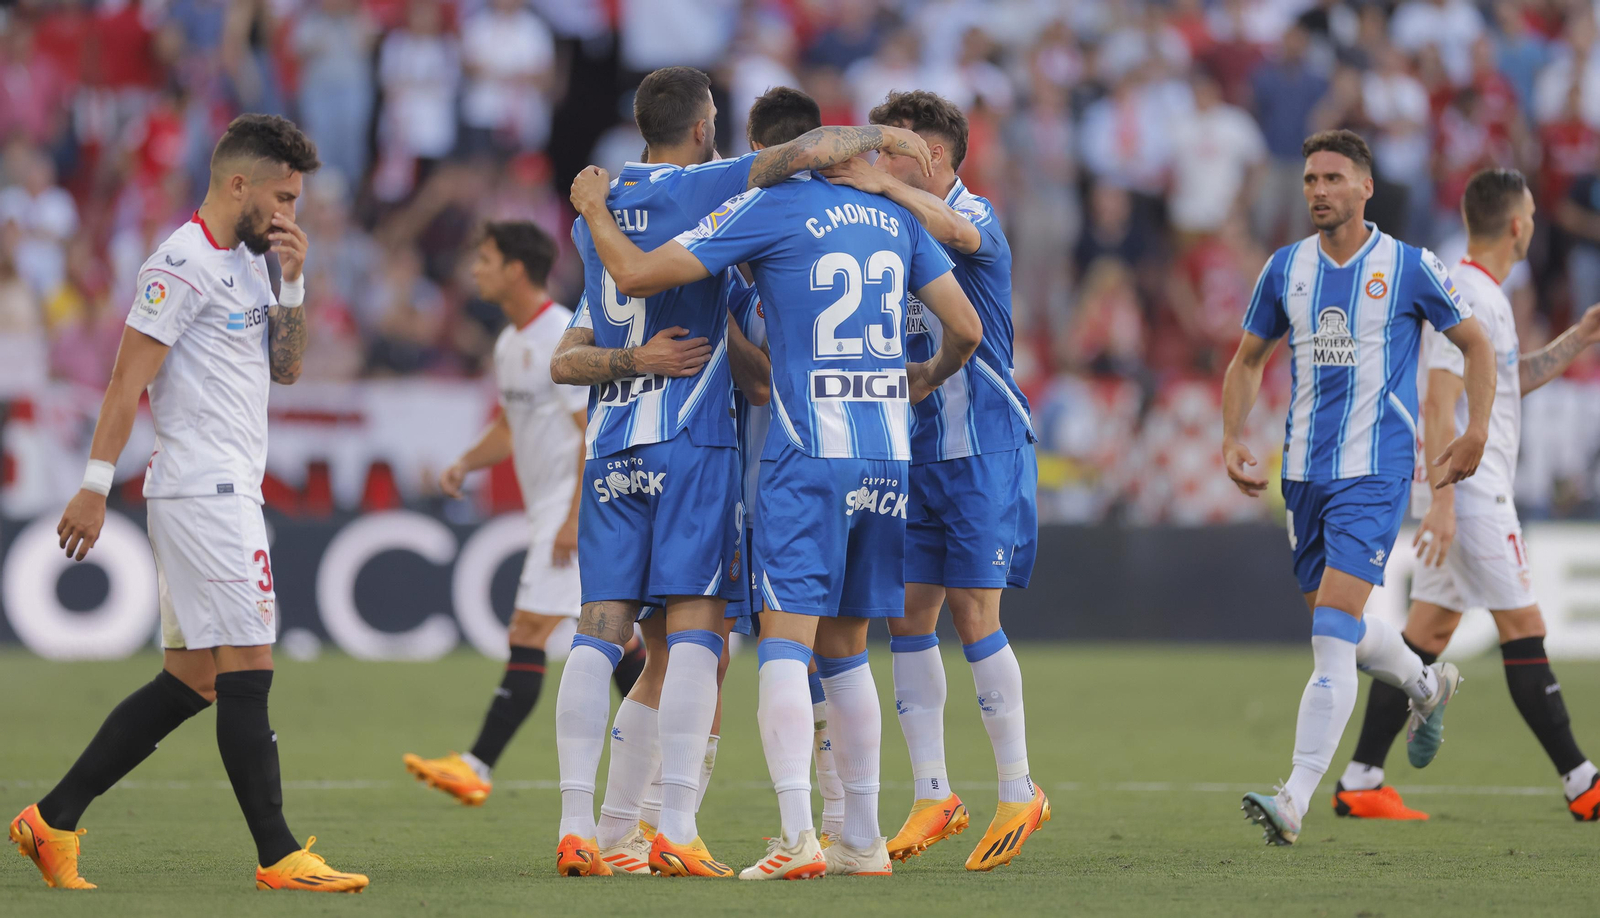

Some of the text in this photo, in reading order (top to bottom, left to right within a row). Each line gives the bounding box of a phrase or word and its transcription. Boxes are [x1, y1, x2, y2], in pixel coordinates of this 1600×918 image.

[244, 304, 269, 329] DEGIR
[810, 250, 905, 361] 23
[1313, 336, 1354, 348] RIVIERA
[1313, 349, 1355, 364] MAYA
[814, 375, 907, 399] DIGI
[862, 477, 898, 487] CRYPTO
[253, 548, 273, 593] 3
